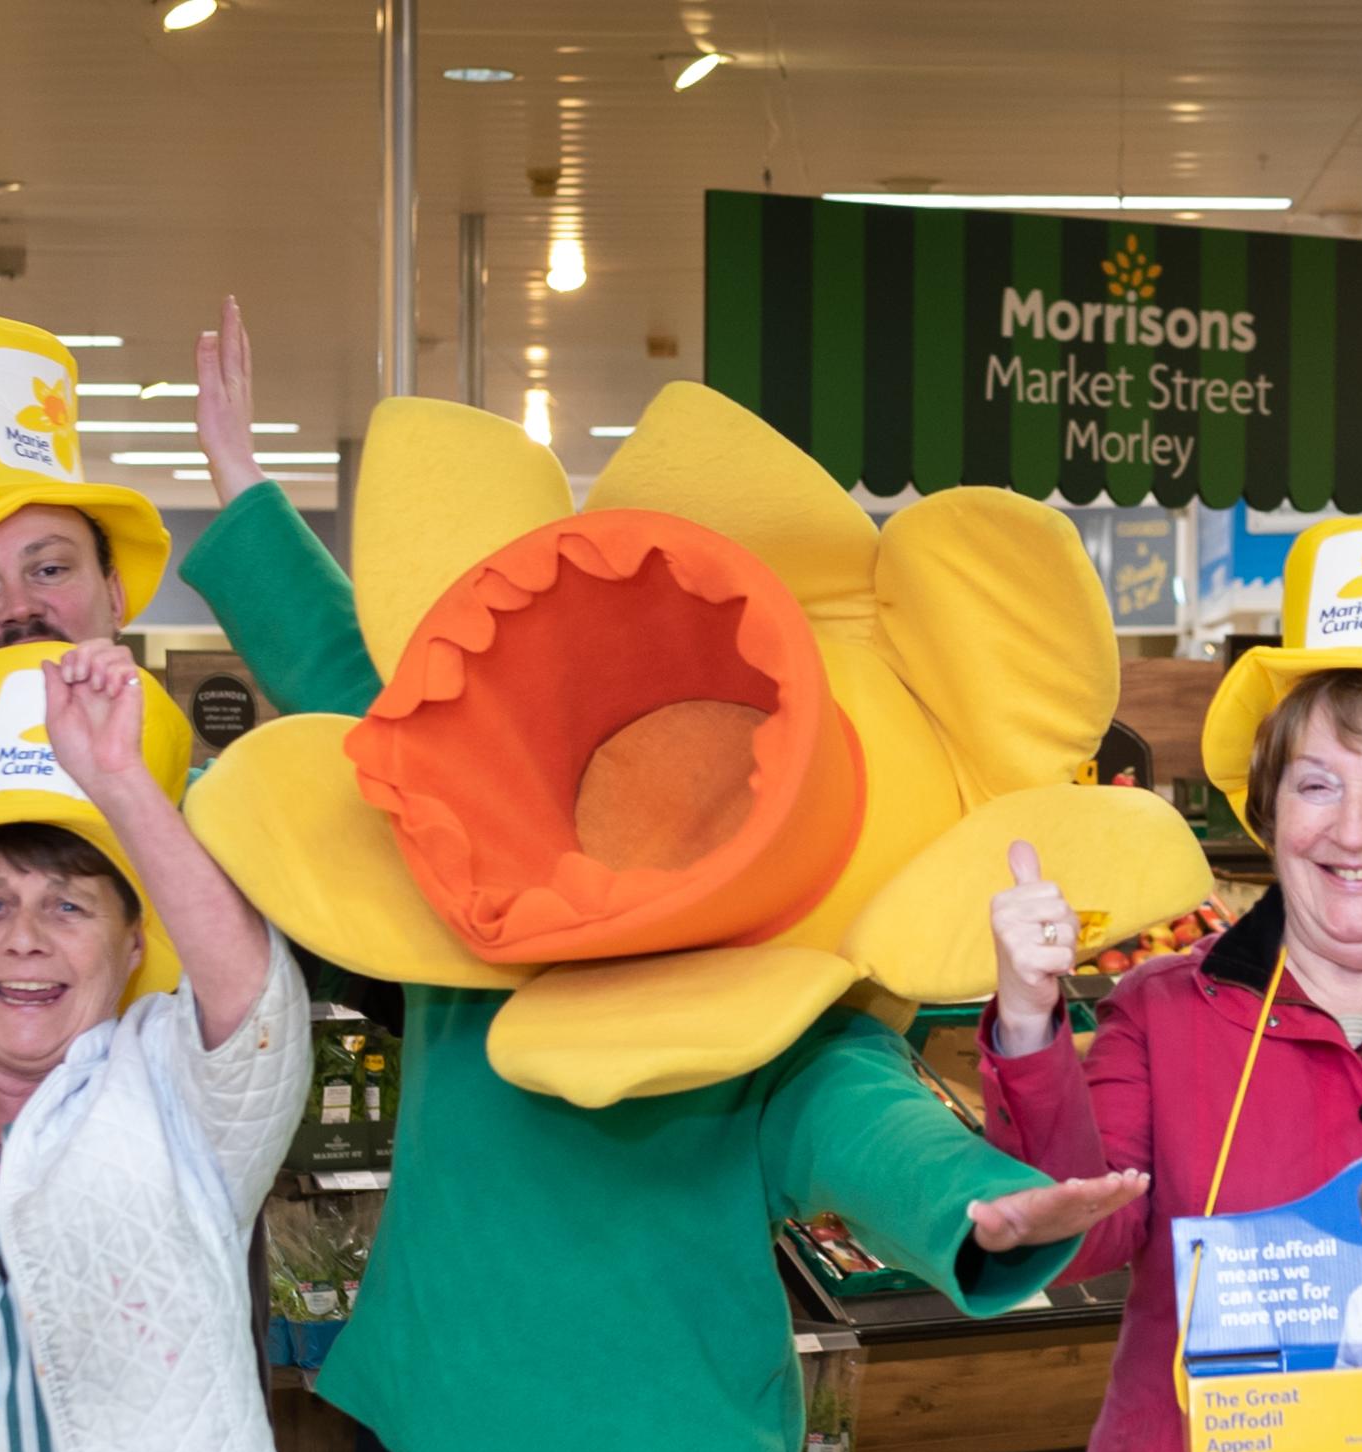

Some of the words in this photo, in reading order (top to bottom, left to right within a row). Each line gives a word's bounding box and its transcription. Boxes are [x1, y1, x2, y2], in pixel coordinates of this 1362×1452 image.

[1001, 287, 1257, 352] Morrisons
[986, 354, 1135, 408] Market
[1147, 362, 1274, 416] Street
[5, 425, 50, 452] Marie
[1065, 418, 1195, 479] Morley
[13, 442, 54, 467] Curie
[1, 761, 55, 776] Curie
[1216, 1246, 1259, 1263] Your
[1262, 1238, 1338, 1261] daffodil
[1217, 1267, 1280, 1285] means
[1283, 1265, 1310, 1280] we
[1219, 1290, 1253, 1306] can
[1257, 1287, 1298, 1303] care
[1302, 1281, 1332, 1301] for
[1221, 1310, 1270, 1327] more
[1273, 1301, 1340, 1328] people
[1204, 1391, 1239, 1409] The
[1245, 1388, 1299, 1407] Great
[1204, 1408, 1284, 1432] Daffodil
